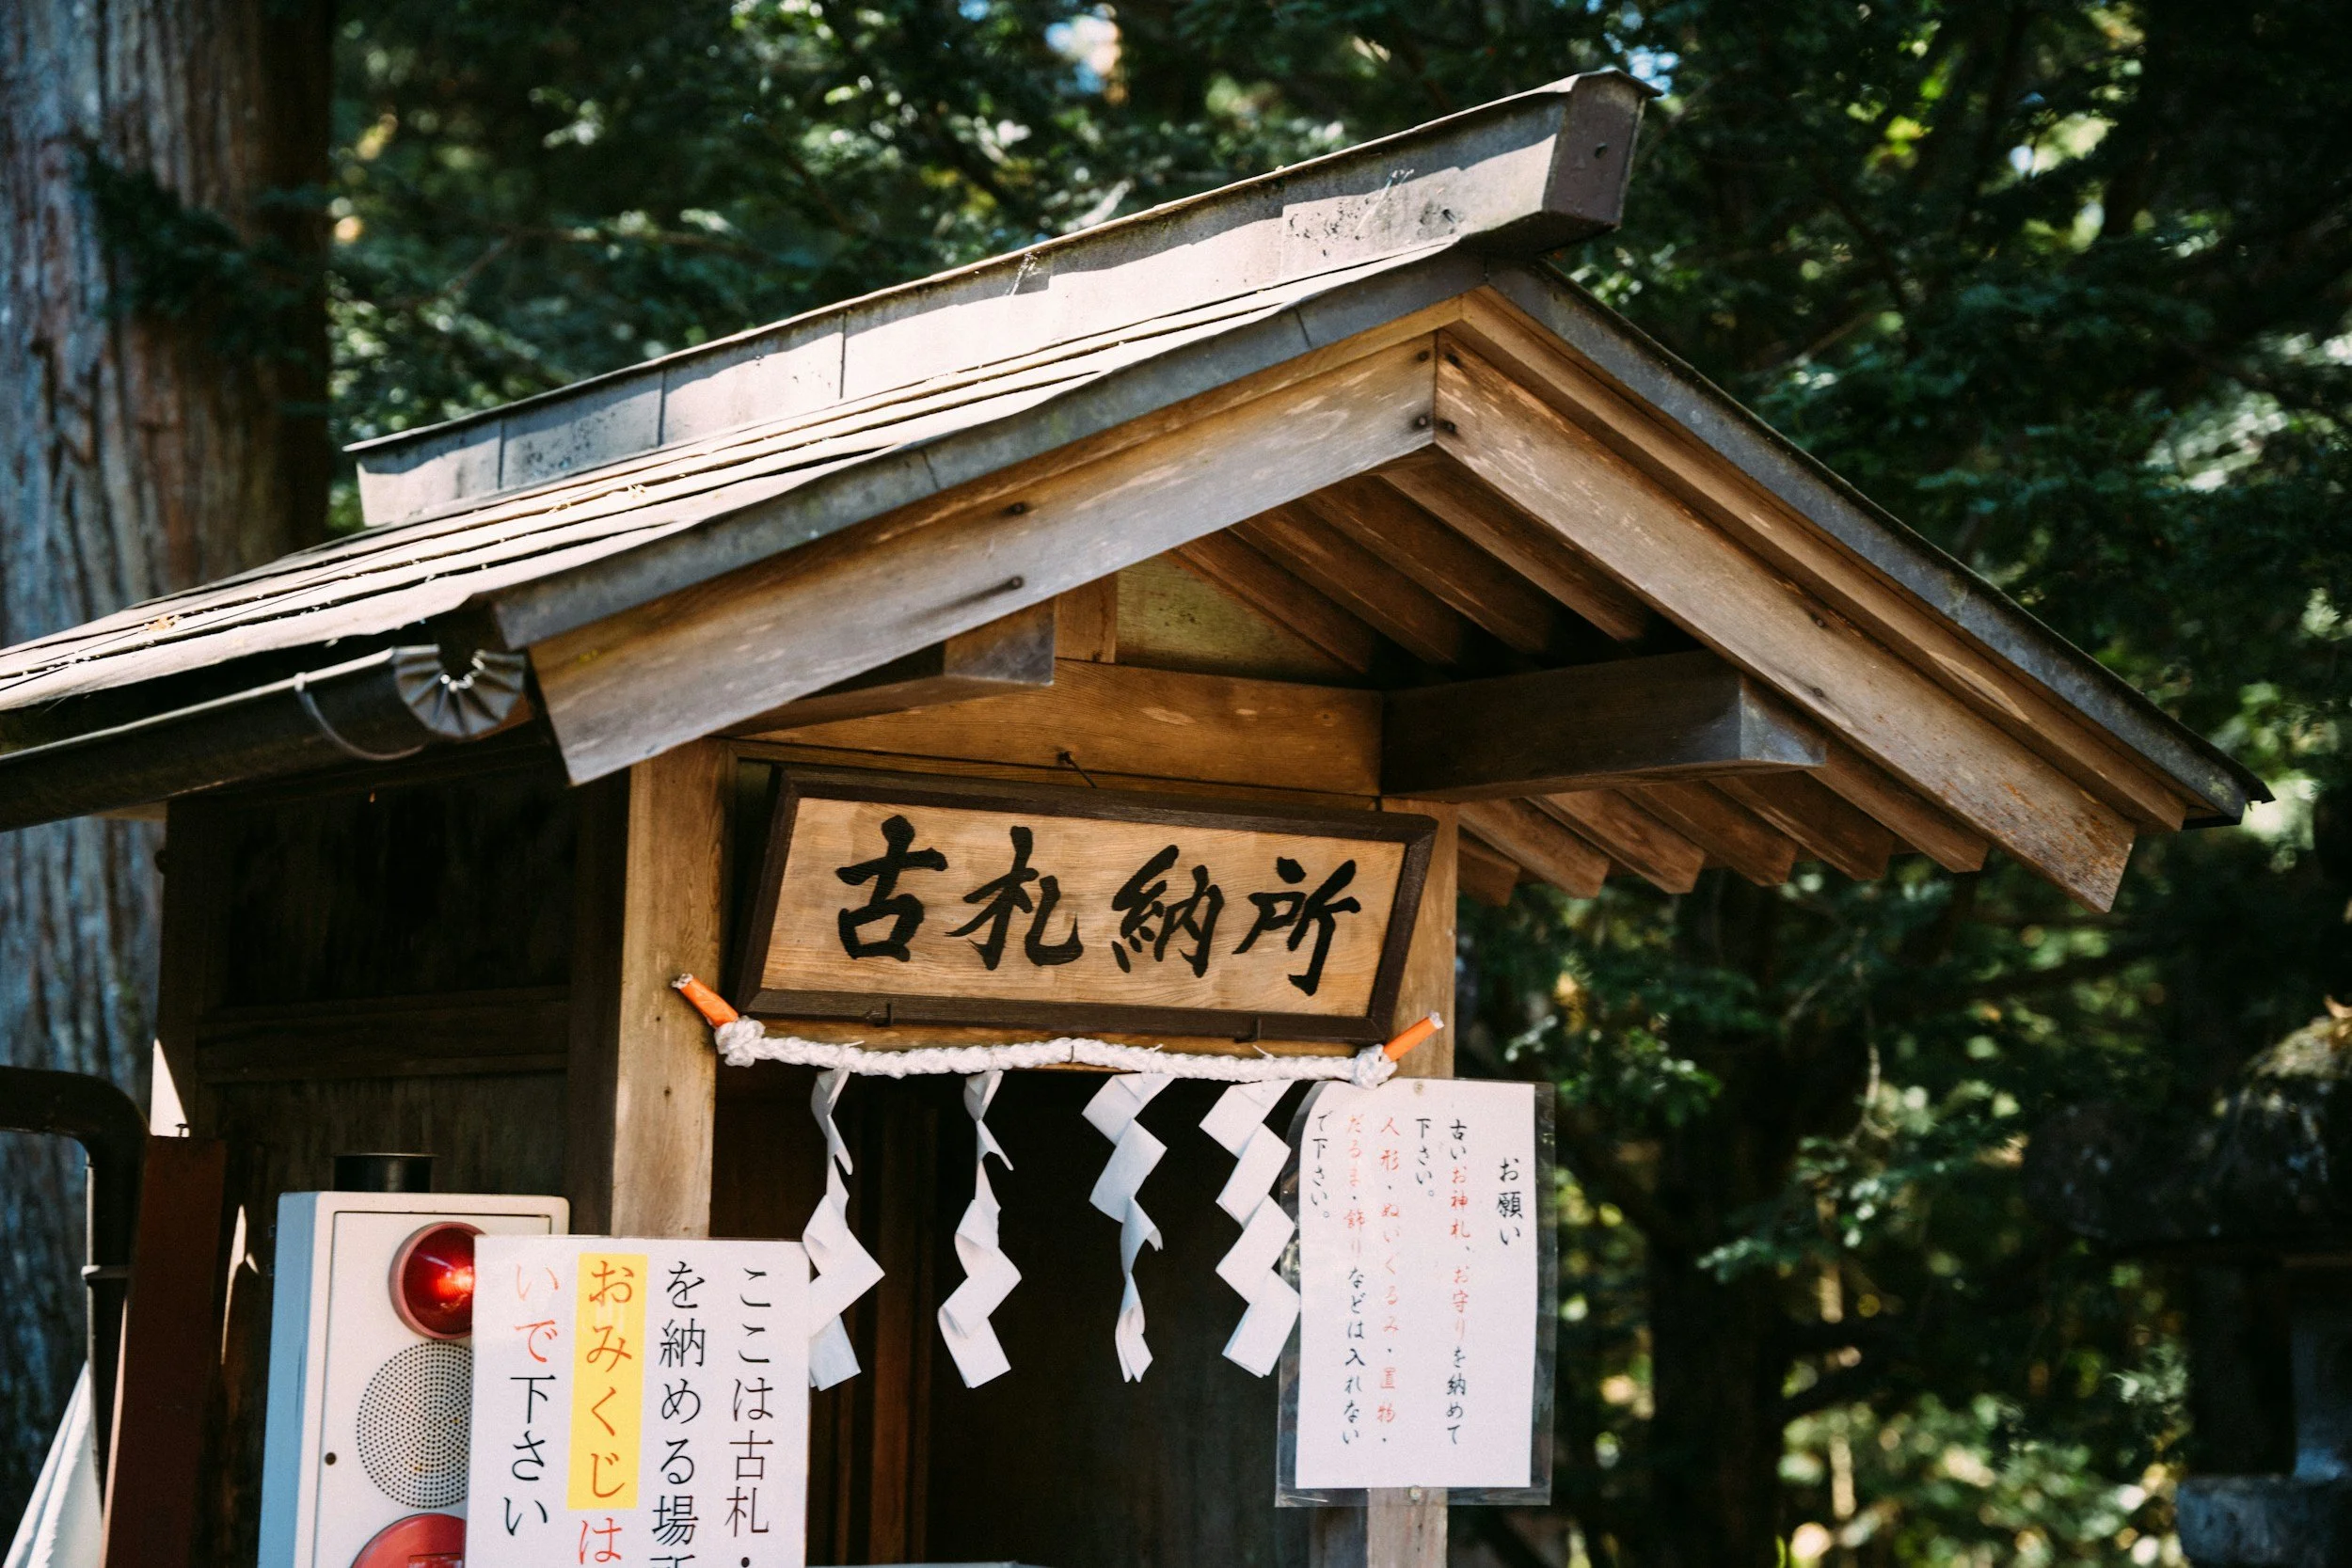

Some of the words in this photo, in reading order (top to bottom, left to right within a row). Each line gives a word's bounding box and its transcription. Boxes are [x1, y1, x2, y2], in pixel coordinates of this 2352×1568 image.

[834, 815, 1361, 995] 古札納所
[1415, 1117, 1434, 1197] 下さい。
[1496, 1158, 1523, 1246] お願い
[503, 1264, 560, 1536] いで下さい
[578, 1259, 634, 1564] おみくじは
[650, 1260, 706, 1568] を納める場
